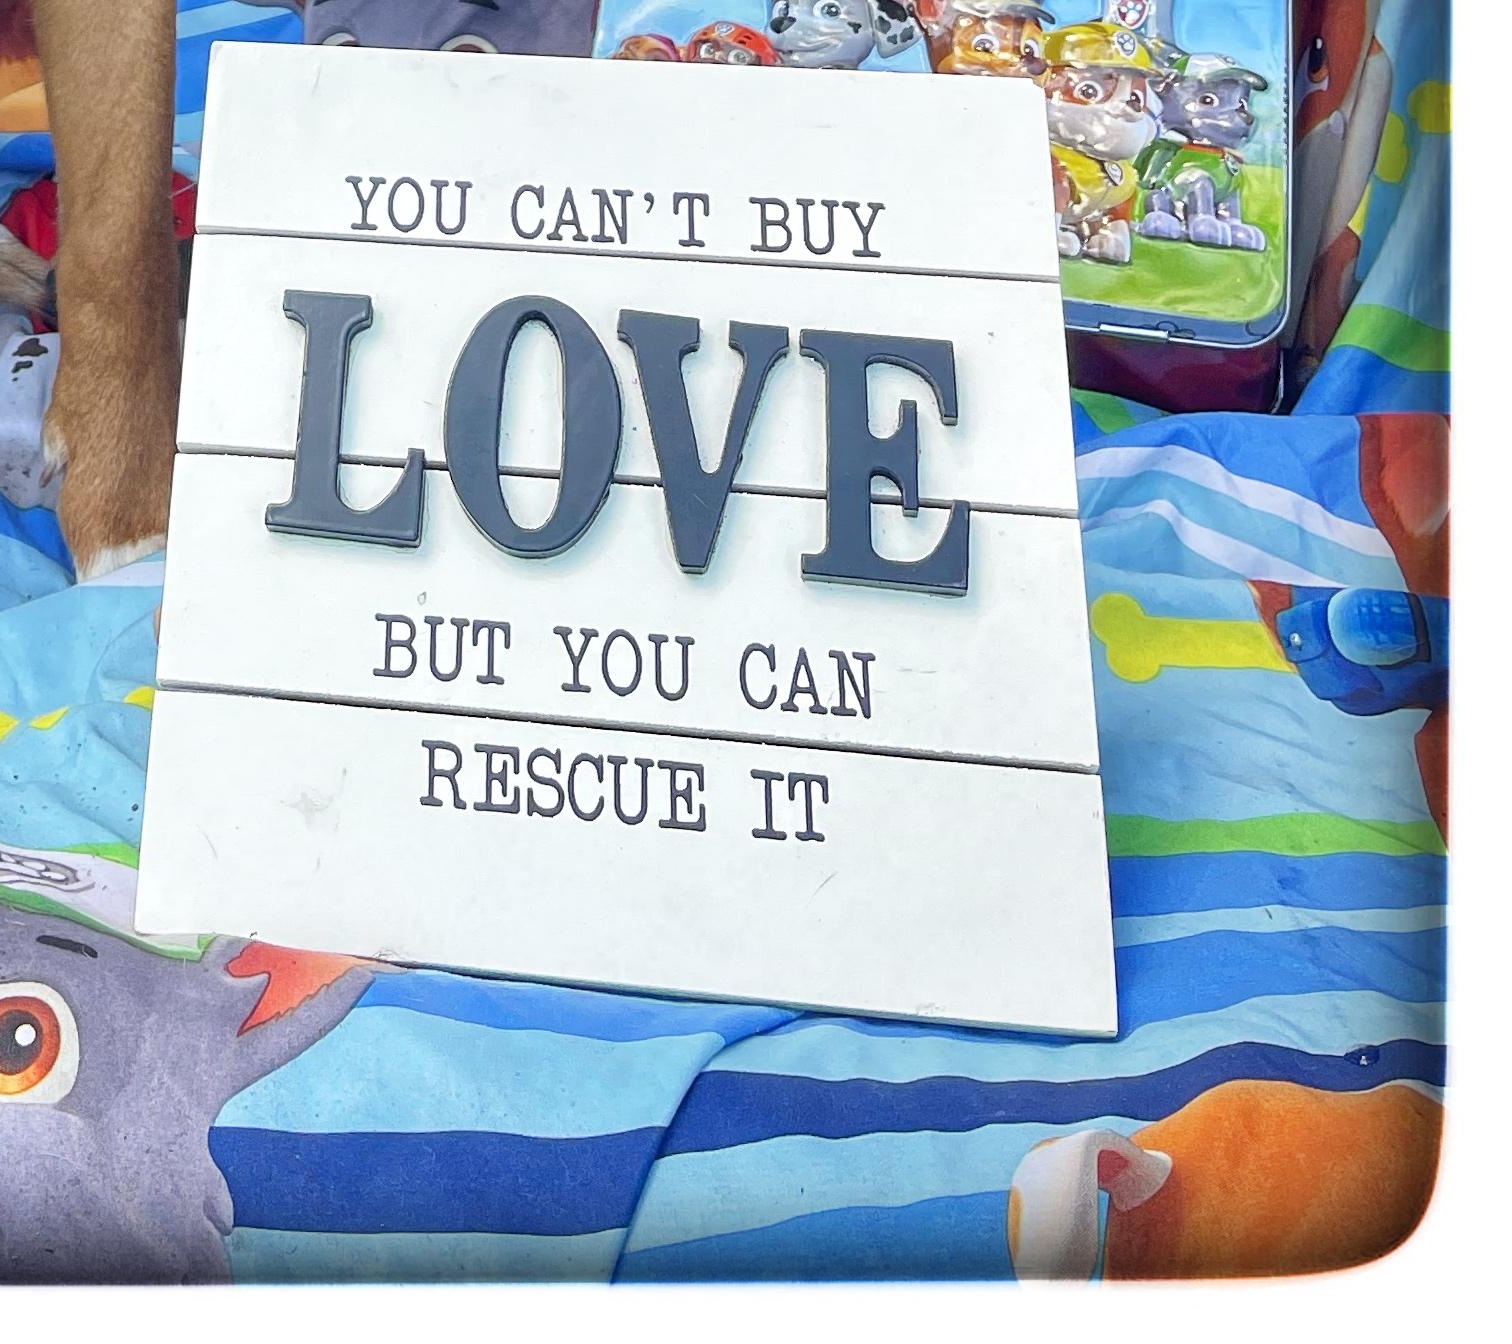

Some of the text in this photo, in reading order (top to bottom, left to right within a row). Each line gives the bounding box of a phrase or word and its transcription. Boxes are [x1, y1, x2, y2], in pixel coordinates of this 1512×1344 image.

[345, 174, 888, 259] YOU CAN'T BUY
[264, 288, 971, 597] LOVE
[372, 612, 877, 720] BUT YOU CAN
[419, 739, 830, 843] RESCUE IT
